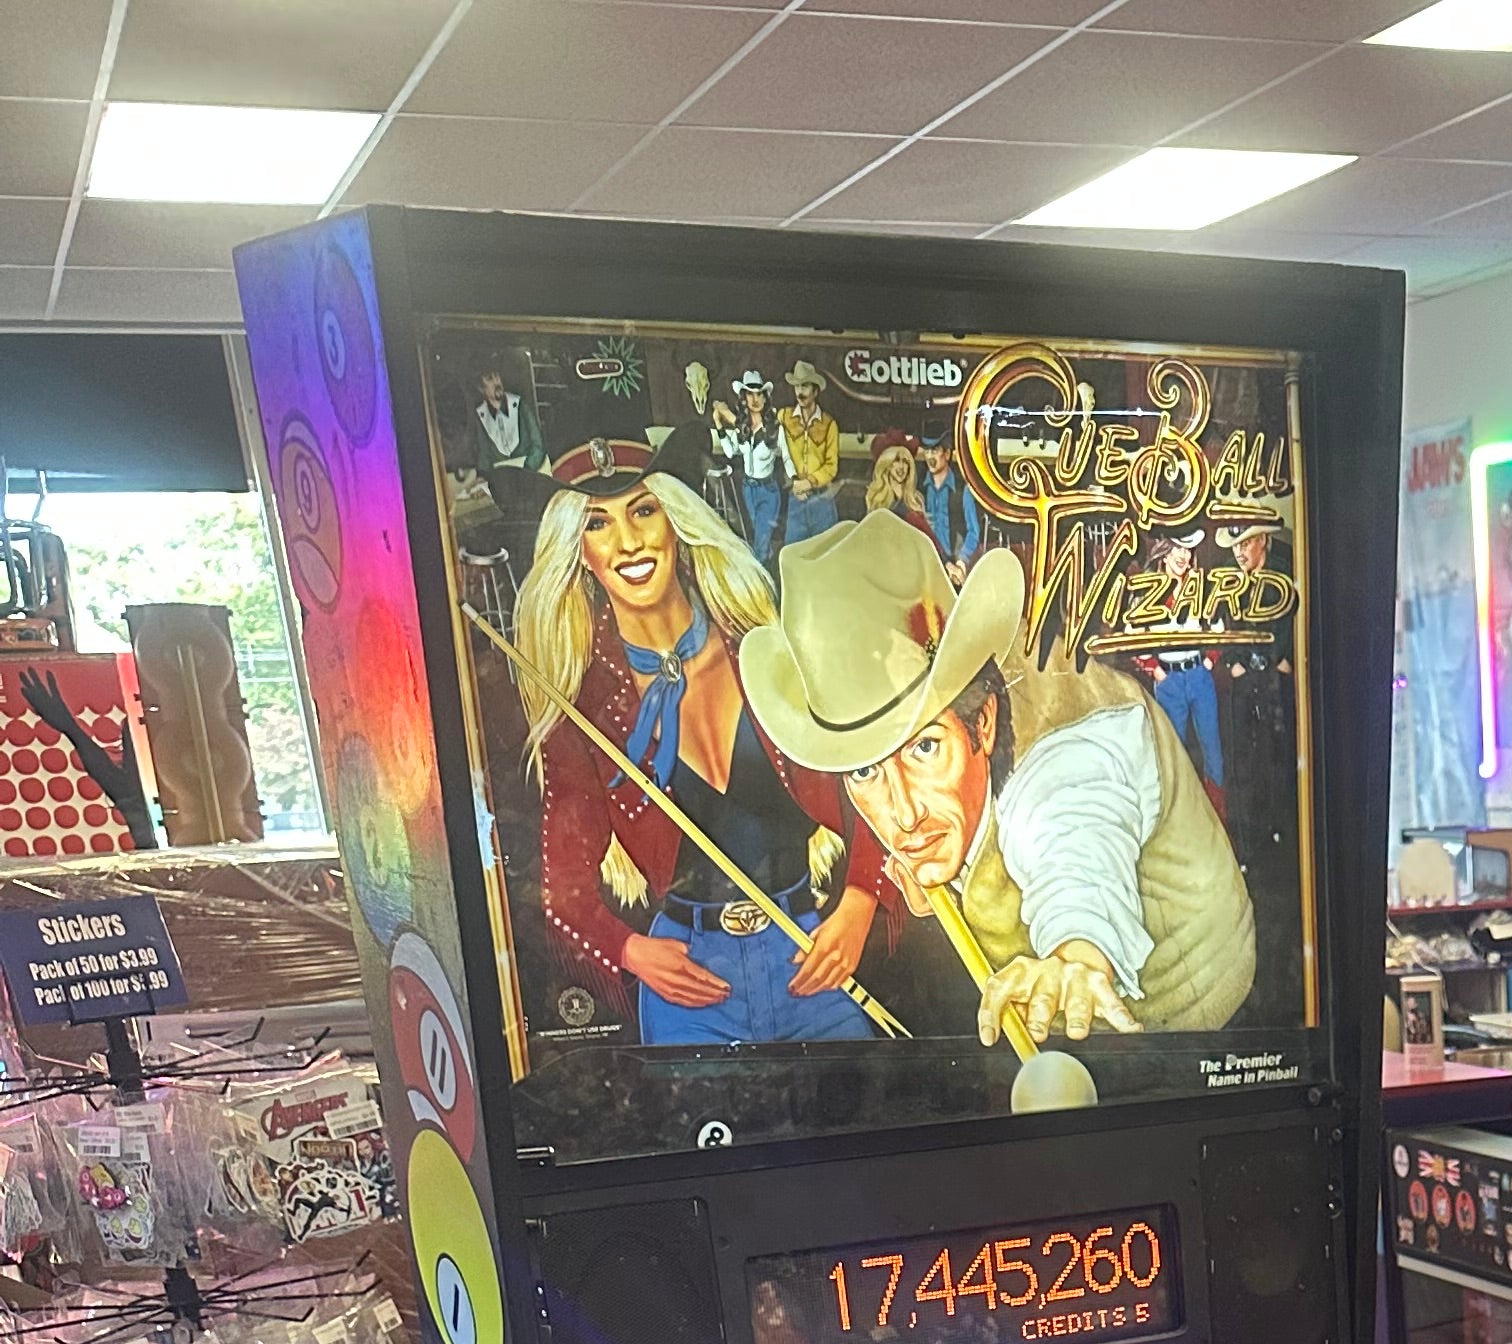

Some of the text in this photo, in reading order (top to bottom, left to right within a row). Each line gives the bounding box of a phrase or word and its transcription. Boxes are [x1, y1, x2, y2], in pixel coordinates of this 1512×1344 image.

[845, 350, 962, 388] Gottlieb
[1128, 357, 1289, 530] BALL
[1023, 519, 1296, 660] WIZARD
[38, 913, 126, 945] Stickers
[29, 947, 159, 981] Pack of 50 for $3.99
[70, 980, 85, 1001] of
[86, 979, 110, 998] 100
[109, 976, 129, 995] for
[1200, 1052, 1282, 1073] The Premier
[1207, 1073, 1242, 1088] Name
[1257, 1066, 1299, 1083] Pinball
[828, 1222, 1161, 1330] 17,445,260
[1021, 1303, 1151, 1340] CREDITS 5
